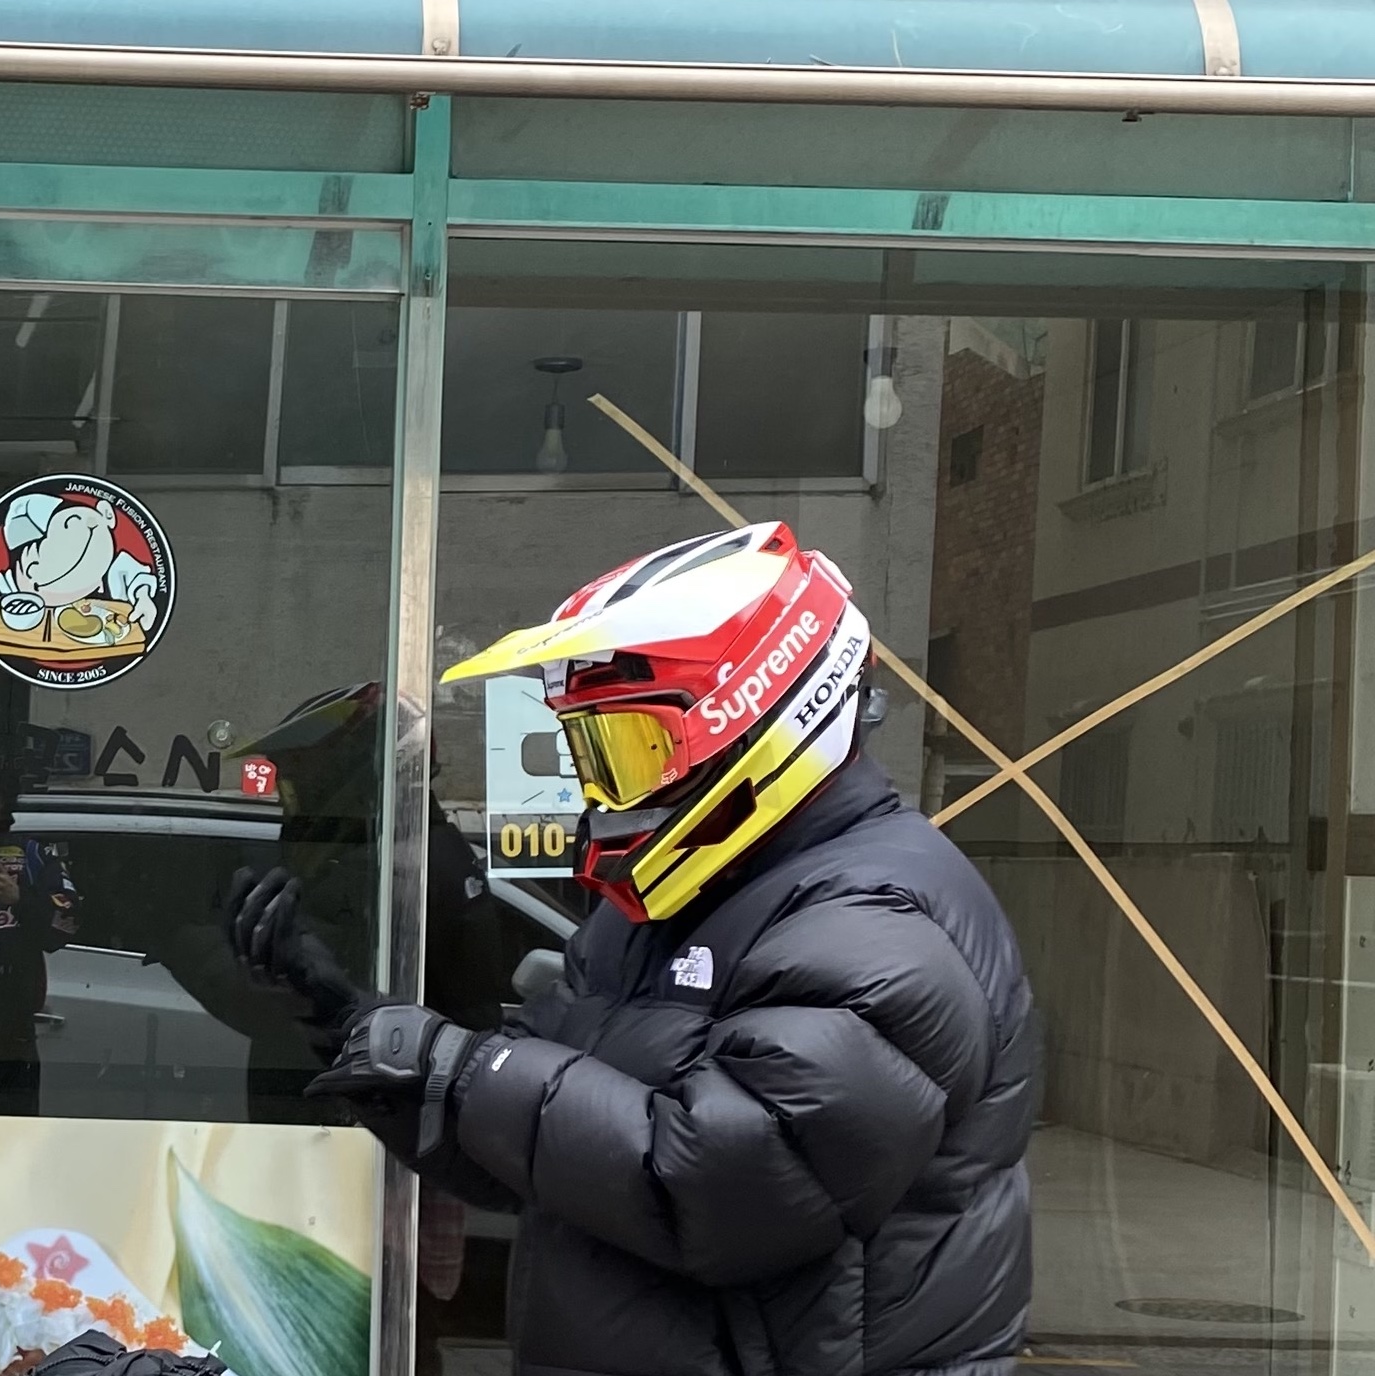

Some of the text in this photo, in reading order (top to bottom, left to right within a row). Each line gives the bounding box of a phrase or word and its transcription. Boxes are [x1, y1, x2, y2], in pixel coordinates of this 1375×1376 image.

[65, 482, 168, 593] JAPANESE FUSION RESTAURANT
[36, 665, 107, 683] SINCE 2005
[699, 610, 821, 735] Supreme
[794, 635, 864, 729] HONDA
[500, 823, 576, 858] 010-
